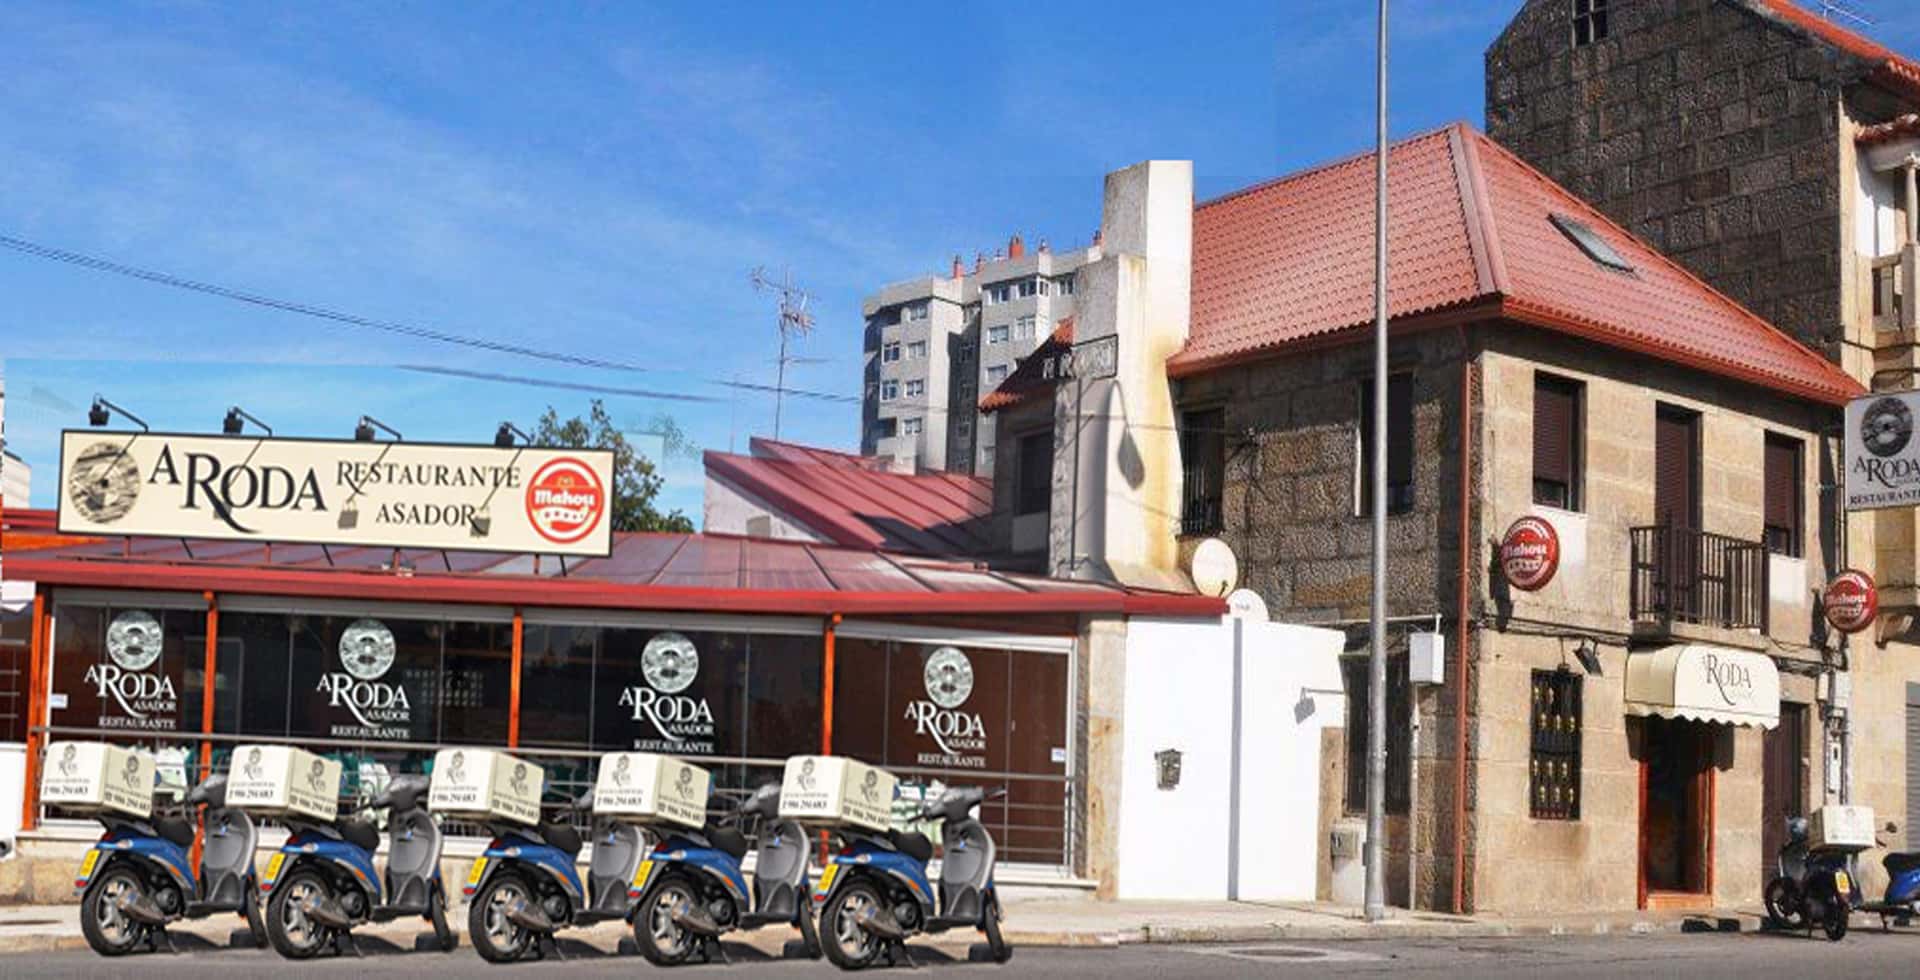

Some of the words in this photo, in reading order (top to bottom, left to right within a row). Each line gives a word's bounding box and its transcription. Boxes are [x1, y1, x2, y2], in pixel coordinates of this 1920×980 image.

[150, 442, 182, 485] A
[180, 452, 329, 534] RODA
[336, 460, 522, 497] RESTAURANTE
[534, 488, 596, 508] Mahou
[375, 502, 490, 536] ASADOR
[83, 664, 99, 684] A
[97, 663, 178, 719] RODA
[316, 673, 331, 692] A
[328, 672, 411, 729] RODA
[98, 716, 177, 730] RESTAURANTE
[618, 687, 633, 706] A
[631, 686, 715, 742] RODA
[903, 700, 917, 720] A
[915, 700, 987, 756] RODA
[330, 725, 411, 740] RESTAURANTE
[633, 739, 715, 754] RESTAURANTE
[917, 752, 986, 769] RESTAURANTE
